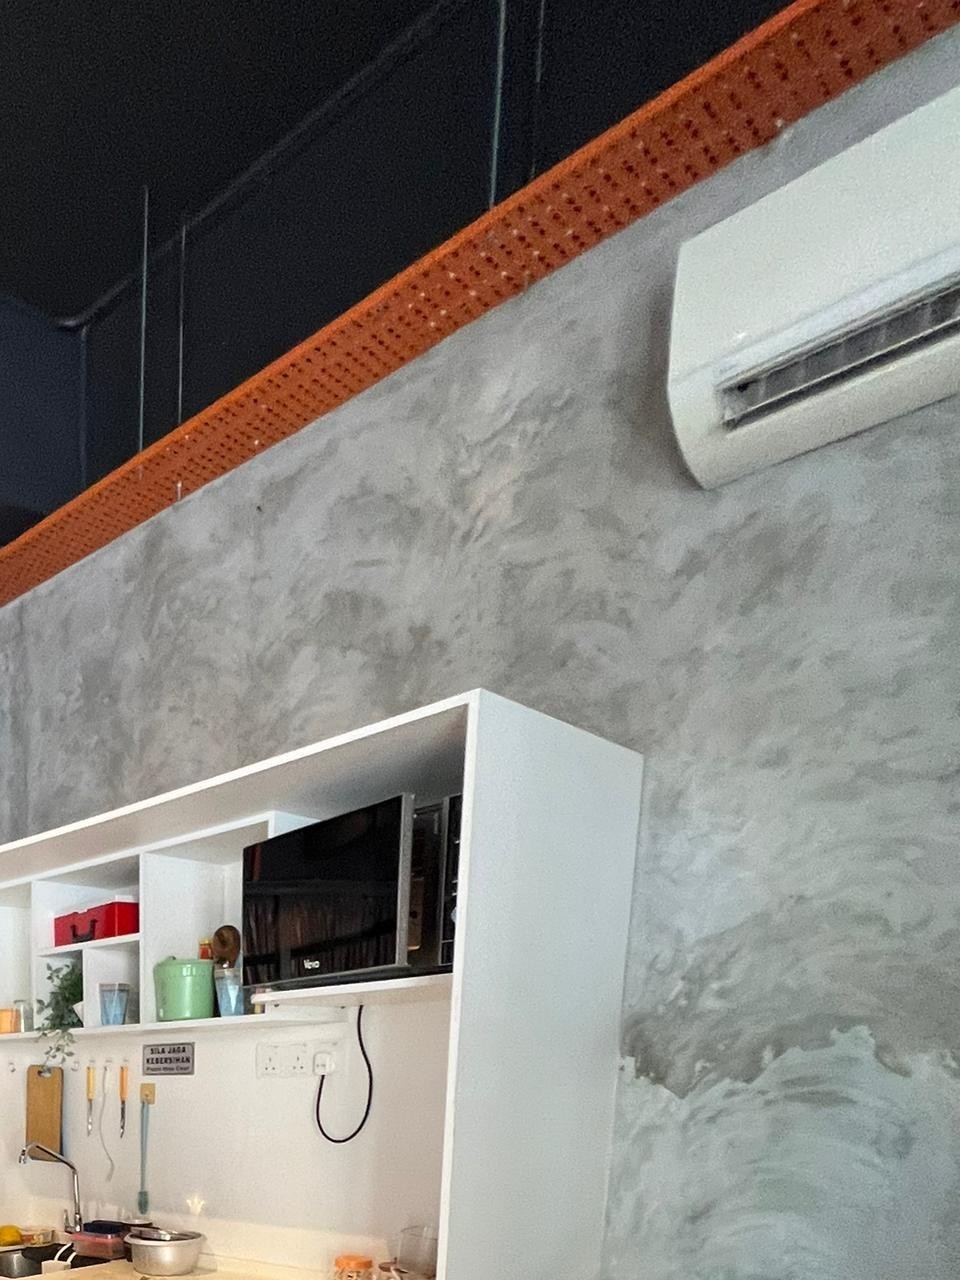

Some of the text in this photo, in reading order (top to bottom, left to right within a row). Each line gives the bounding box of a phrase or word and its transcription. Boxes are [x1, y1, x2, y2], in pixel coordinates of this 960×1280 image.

[150, 1046, 186, 1055] SILA JAGA
[146, 1056, 191, 1065] KEBERSIHAN
